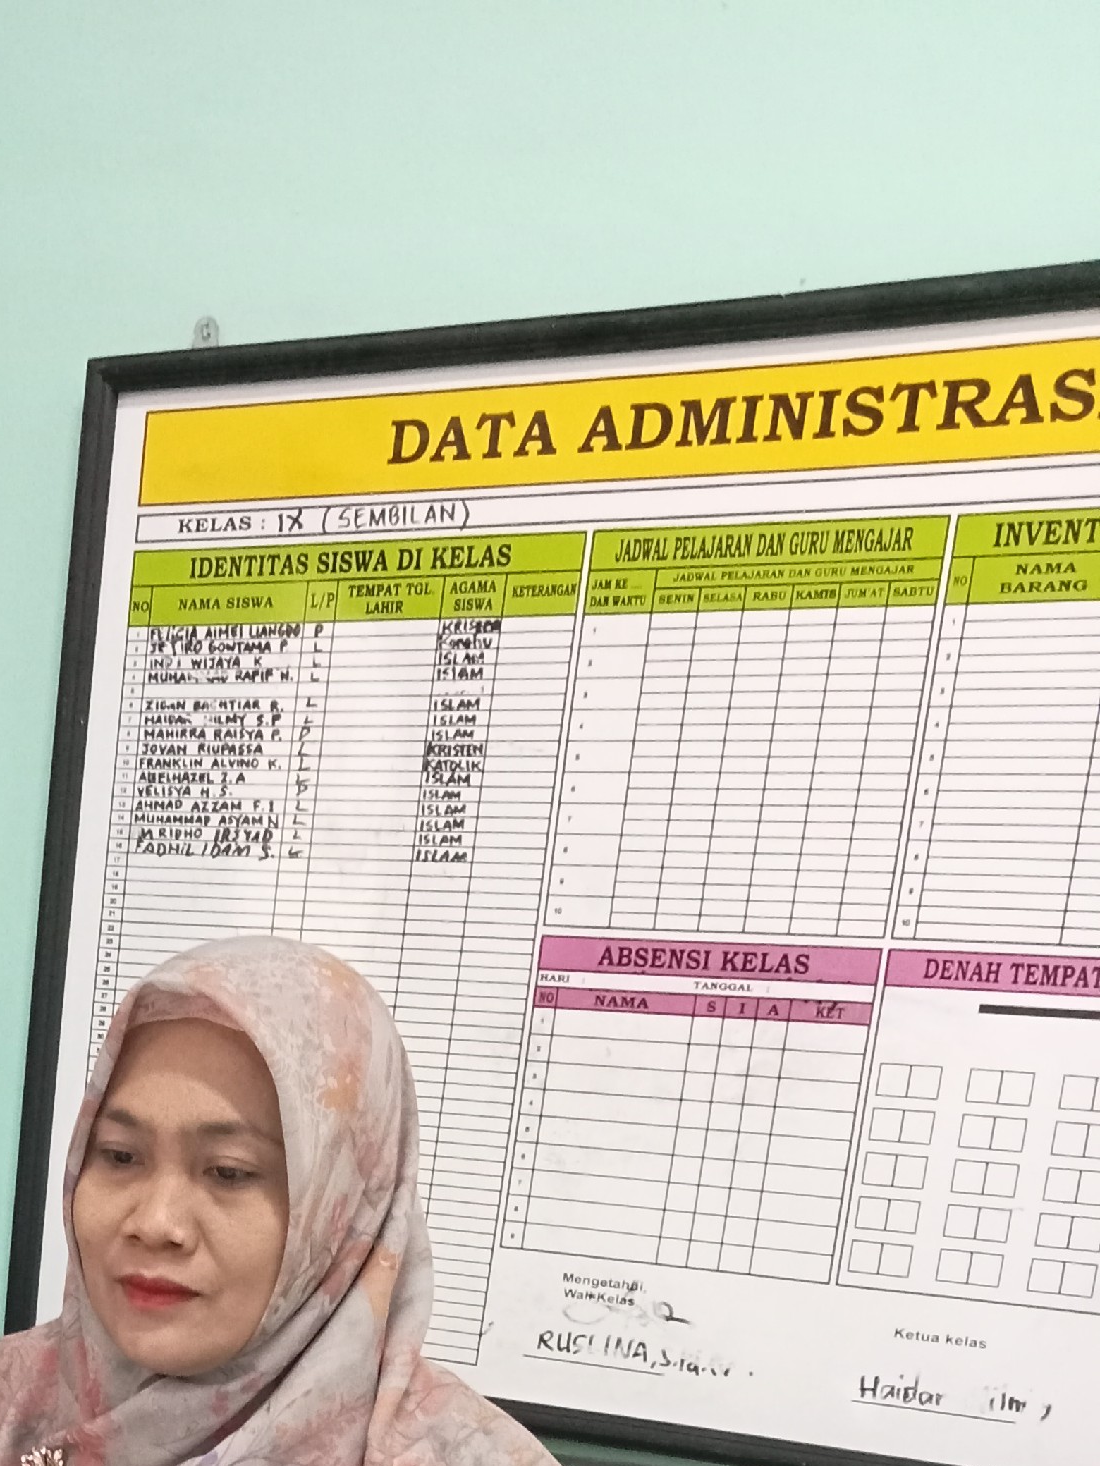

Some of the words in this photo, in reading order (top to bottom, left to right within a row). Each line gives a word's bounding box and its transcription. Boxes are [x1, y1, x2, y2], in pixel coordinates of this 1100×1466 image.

[386, 408, 557, 465] DATA
[576, 366, 1100, 454] ADMINISTRAS
[178, 517, 252, 533] KELAS
[279, 509, 304, 533] IX
[615, 536, 668, 563] JADWAL
[673, 534, 752, 561] PELAJARAN
[756, 532, 786, 558] DAN
[790, 529, 828, 554] GURU
[832, 527, 915, 552] MENGAJAR
[190, 553, 309, 579] IDENTITAS
[317, 549, 388, 574] SISWA
[397, 548, 422, 571] DI
[431, 544, 512, 569] KELAS
[1015, 562, 1077, 575] NAMA
[348, 583, 400, 597] TEMPAT
[450, 580, 497, 595] AGAMA
[512, 582, 578, 597] KETERANGAN
[999, 579, 1088, 594] BARANG
[132, 601, 149, 612] NO
[178, 598, 221, 611] NAMA
[226, 596, 274, 609] SISWA
[365, 601, 404, 614] LAHIR
[453, 598, 493, 612] SISWA
[433, 697, 481, 711] ISLAM
[433, 714, 477, 727] ISLAM
[430, 728, 476, 741] ISLAM
[139, 757, 203, 770] FRANKLIN
[425, 770, 471, 787] ISLAM
[422, 789, 461, 801] ISLAM
[421, 803, 467, 817] ISLAM
[419, 818, 466, 832] ISLAM
[418, 833, 463, 847] ISLAM
[415, 848, 468, 863] ISLAM
[598, 945, 711, 971] ABSENSI
[721, 949, 810, 975] KELAS
[540, 973, 570, 984] HARI
[923, 957, 1003, 984] DENAH
[1010, 962, 1100, 989] TEMPAT
[694, 980, 753, 992] TANGGAL
[594, 994, 649, 1009] NAMA
[706, 1001, 717, 1013] S
[767, 1004, 779, 1017] A
[815, 1005, 846, 1020] KET
[894, 1327, 940, 1343] Ketua
[946, 1333, 988, 1350] kelas
